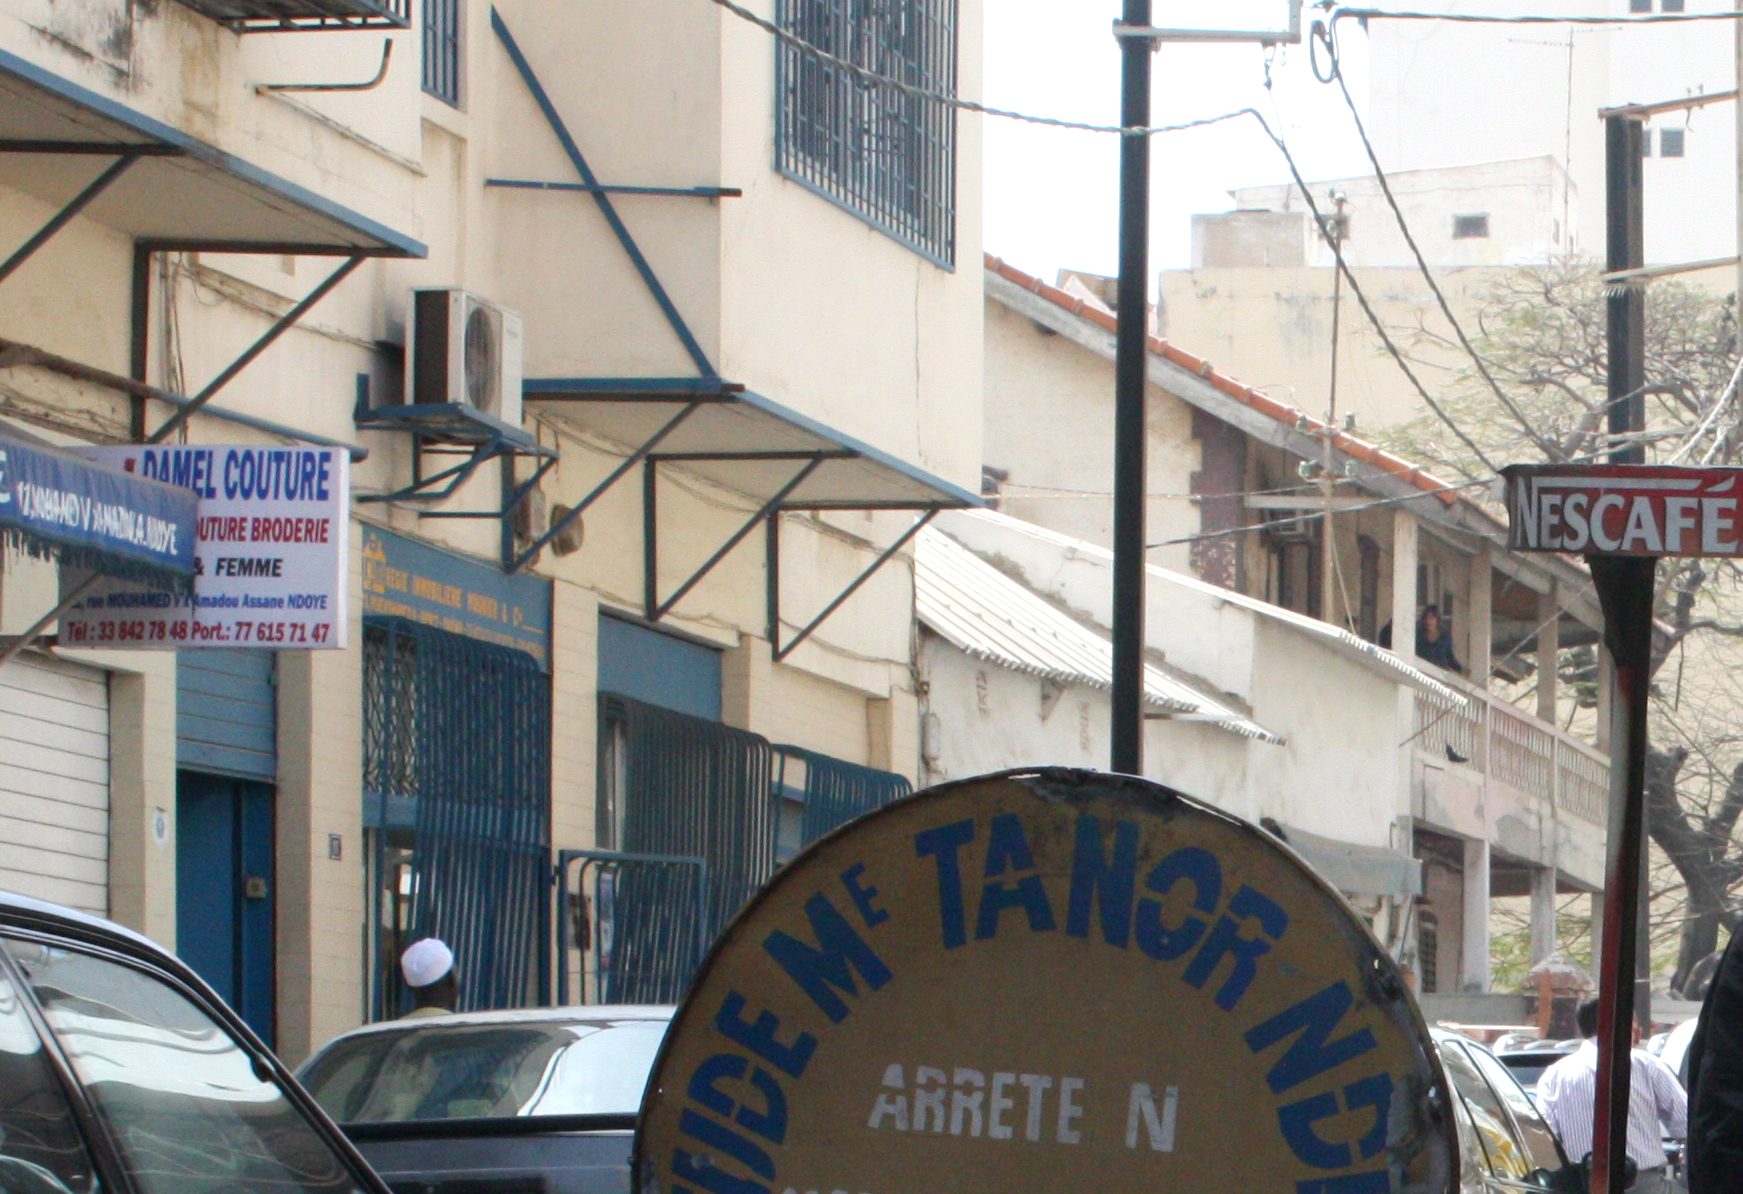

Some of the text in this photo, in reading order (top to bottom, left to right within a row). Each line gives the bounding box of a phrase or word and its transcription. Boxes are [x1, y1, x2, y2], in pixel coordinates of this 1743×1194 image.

[143, 449, 332, 501] DAMEL COUTURE
[251, 516, 330, 544] BRODERIE
[1515, 476, 1739, 554] NESCAFÉ
[215, 557, 283, 578] FEMME
[241, 594, 284, 610] Assane
[287, 594, 328, 610] NDOYE
[99, 620, 116, 641] 33
[119, 620, 145, 641] 842
[149, 621, 166, 641] 78
[170, 620, 188, 640] 48
[235, 621, 253, 641] 77
[256, 621, 284, 643] 615
[289, 622, 306, 643] 71
[311, 623, 330, 643] 47
[913, 812, 1289, 1012] TANOR
[867, 1063, 1179, 1153] ARRETE N
